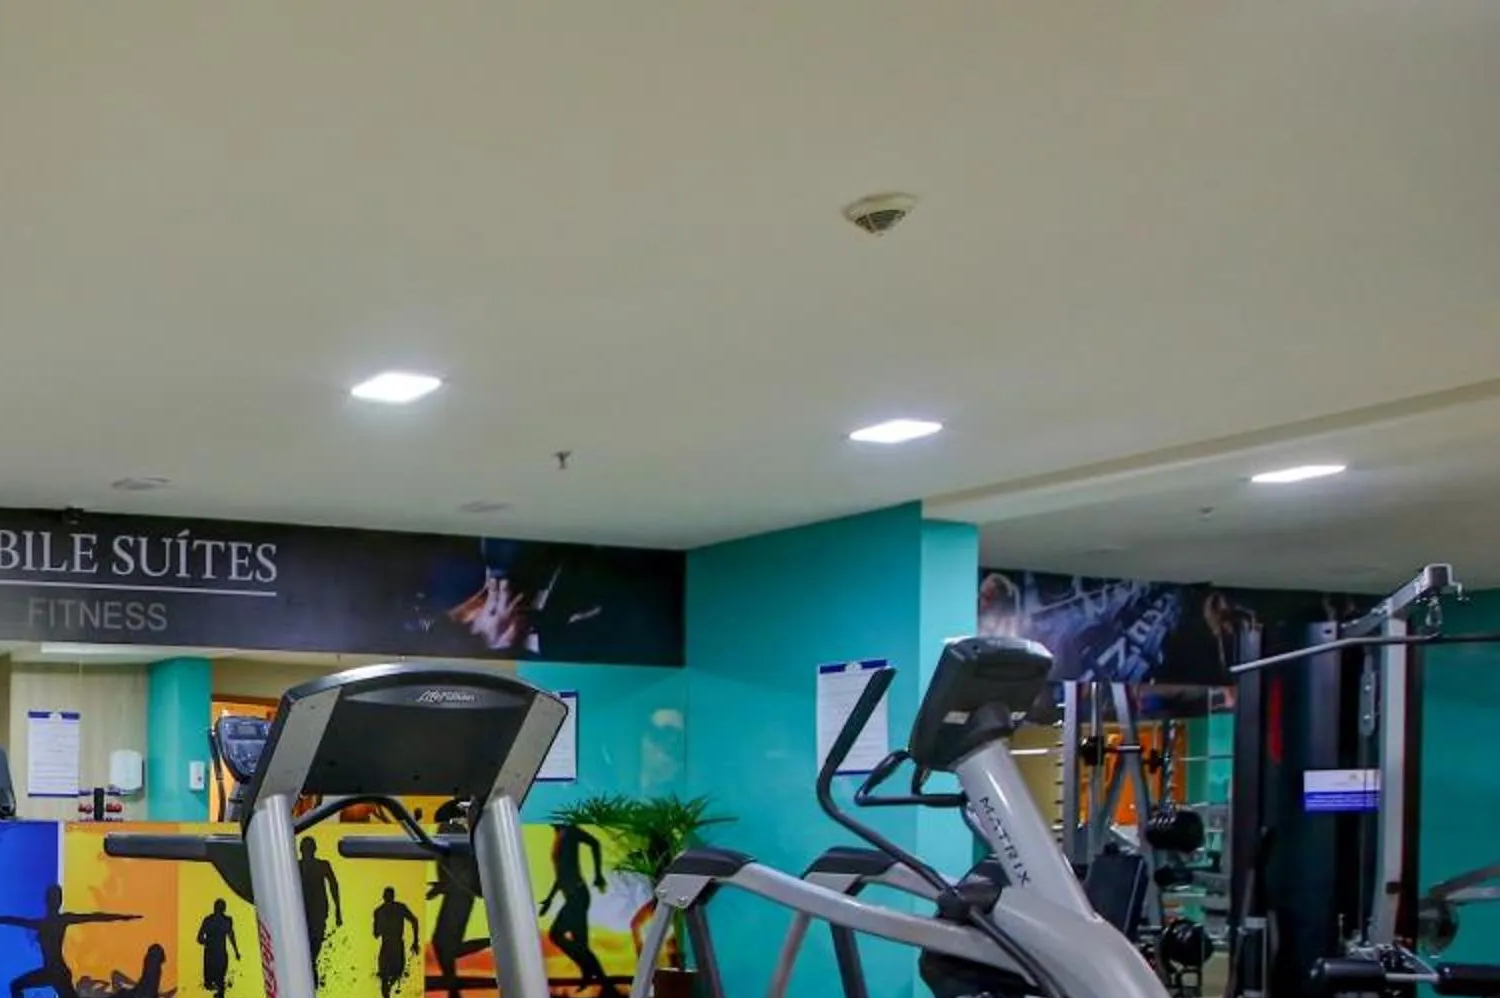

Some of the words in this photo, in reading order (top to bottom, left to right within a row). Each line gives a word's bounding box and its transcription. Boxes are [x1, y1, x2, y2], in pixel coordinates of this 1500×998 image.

[112, 529, 277, 582] SUÍTES
[26, 597, 168, 632] FITNESS
[979, 797, 1031, 887] MATRIX
